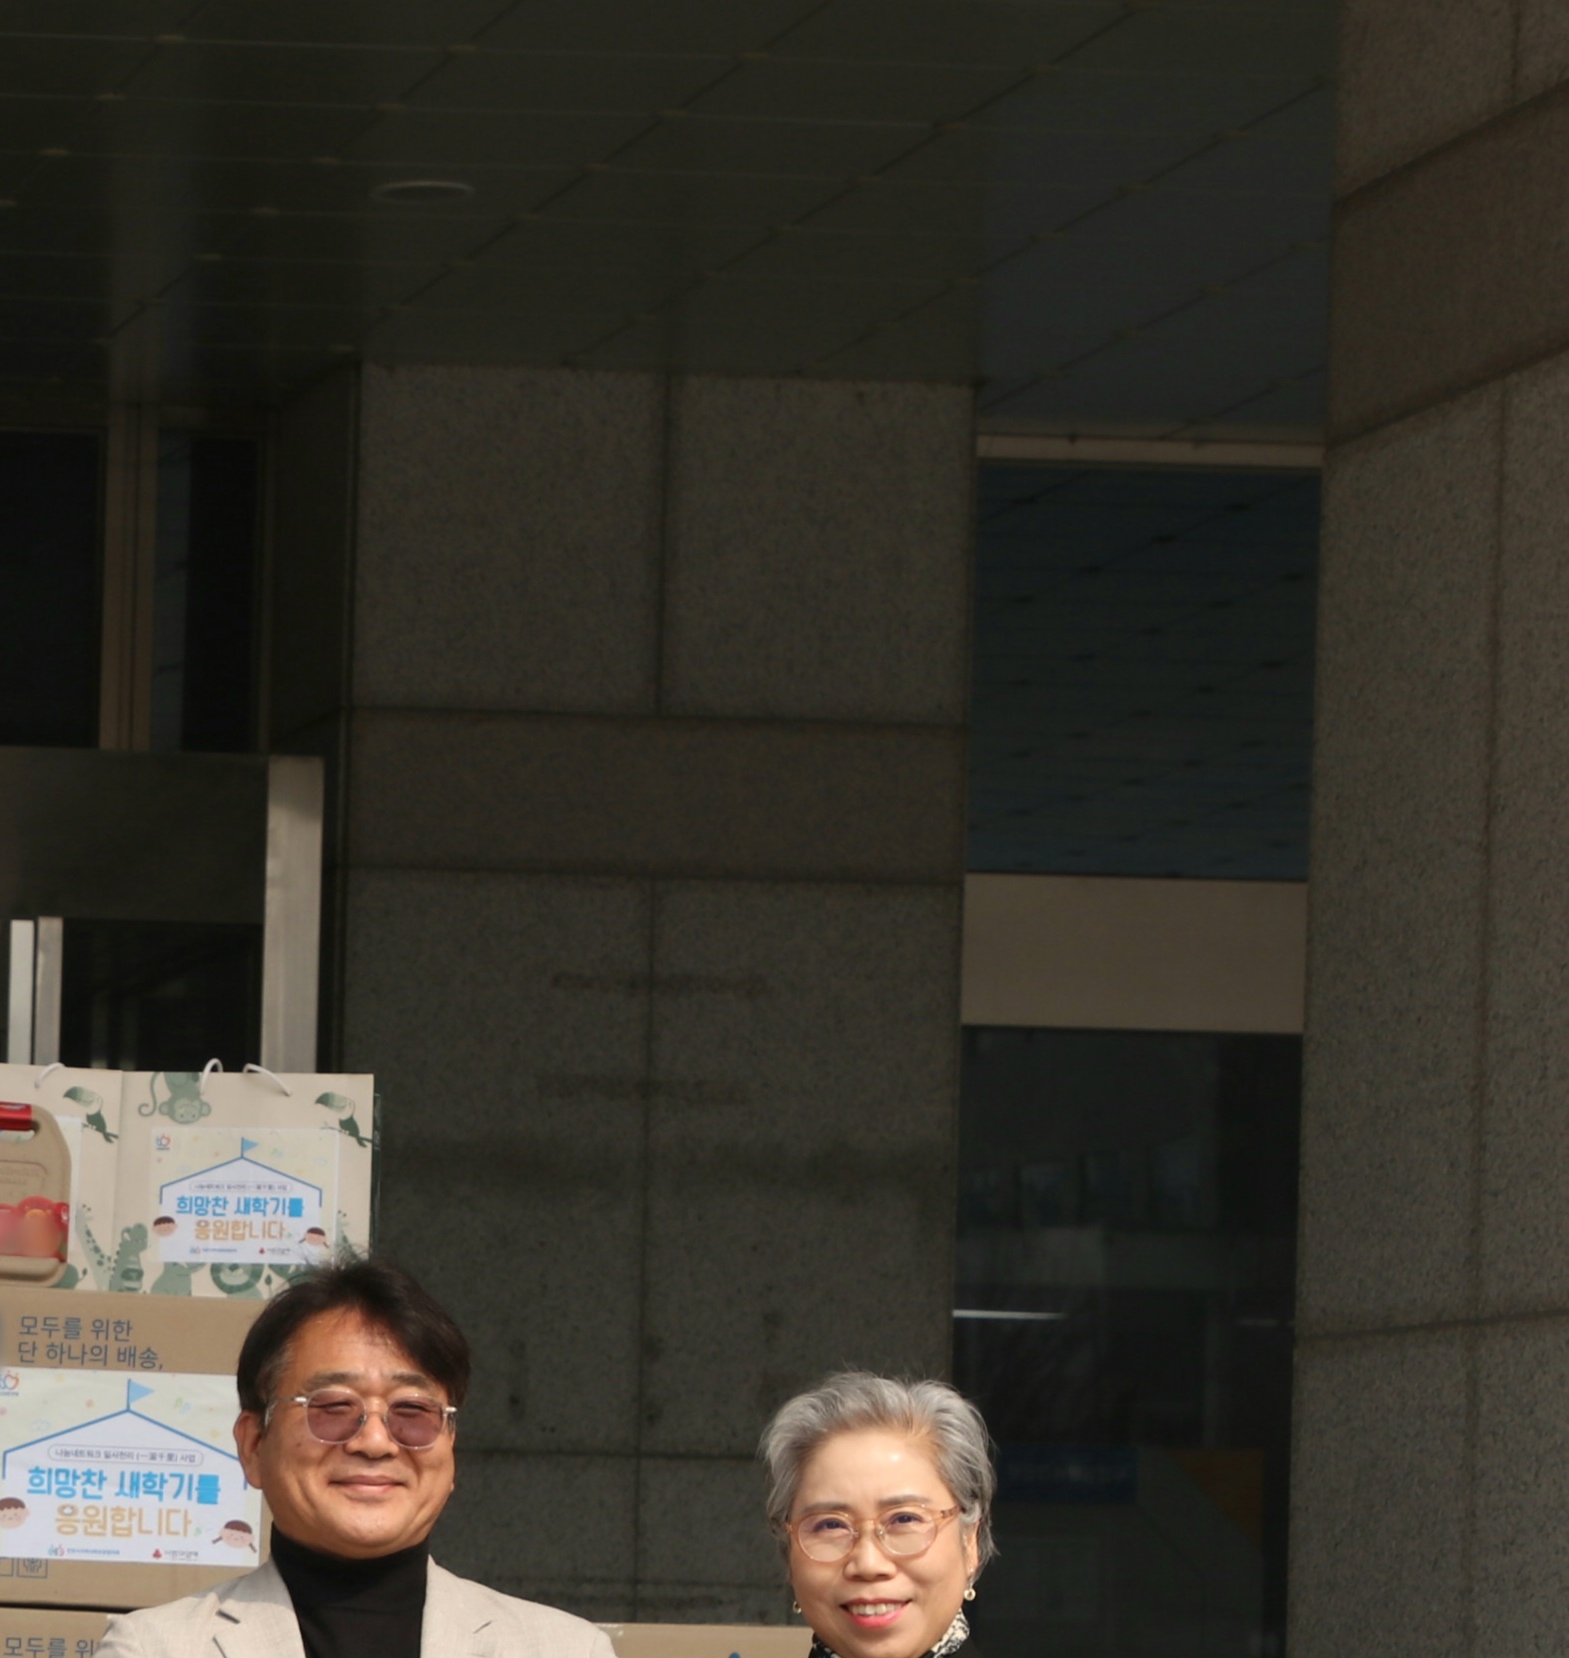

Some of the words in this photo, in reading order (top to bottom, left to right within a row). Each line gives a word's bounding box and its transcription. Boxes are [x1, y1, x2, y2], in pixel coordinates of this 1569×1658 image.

[176, 1195, 229, 1217] 희망찬
[234, 1196, 305, 1218] 새학기를
[194, 1219, 286, 1241] 응원합니다
[18, 1316, 84, 1340] 모두를
[91, 1317, 133, 1342] 위한
[18, 1341, 38, 1364] 단
[46, 1342, 109, 1367] 하나의
[116, 1345, 164, 1371] 배송,
[27, 1466, 108, 1501] 희망찬
[115, 1471, 222, 1505] 새학기를
[54, 1503, 193, 1539] 응원합니다
